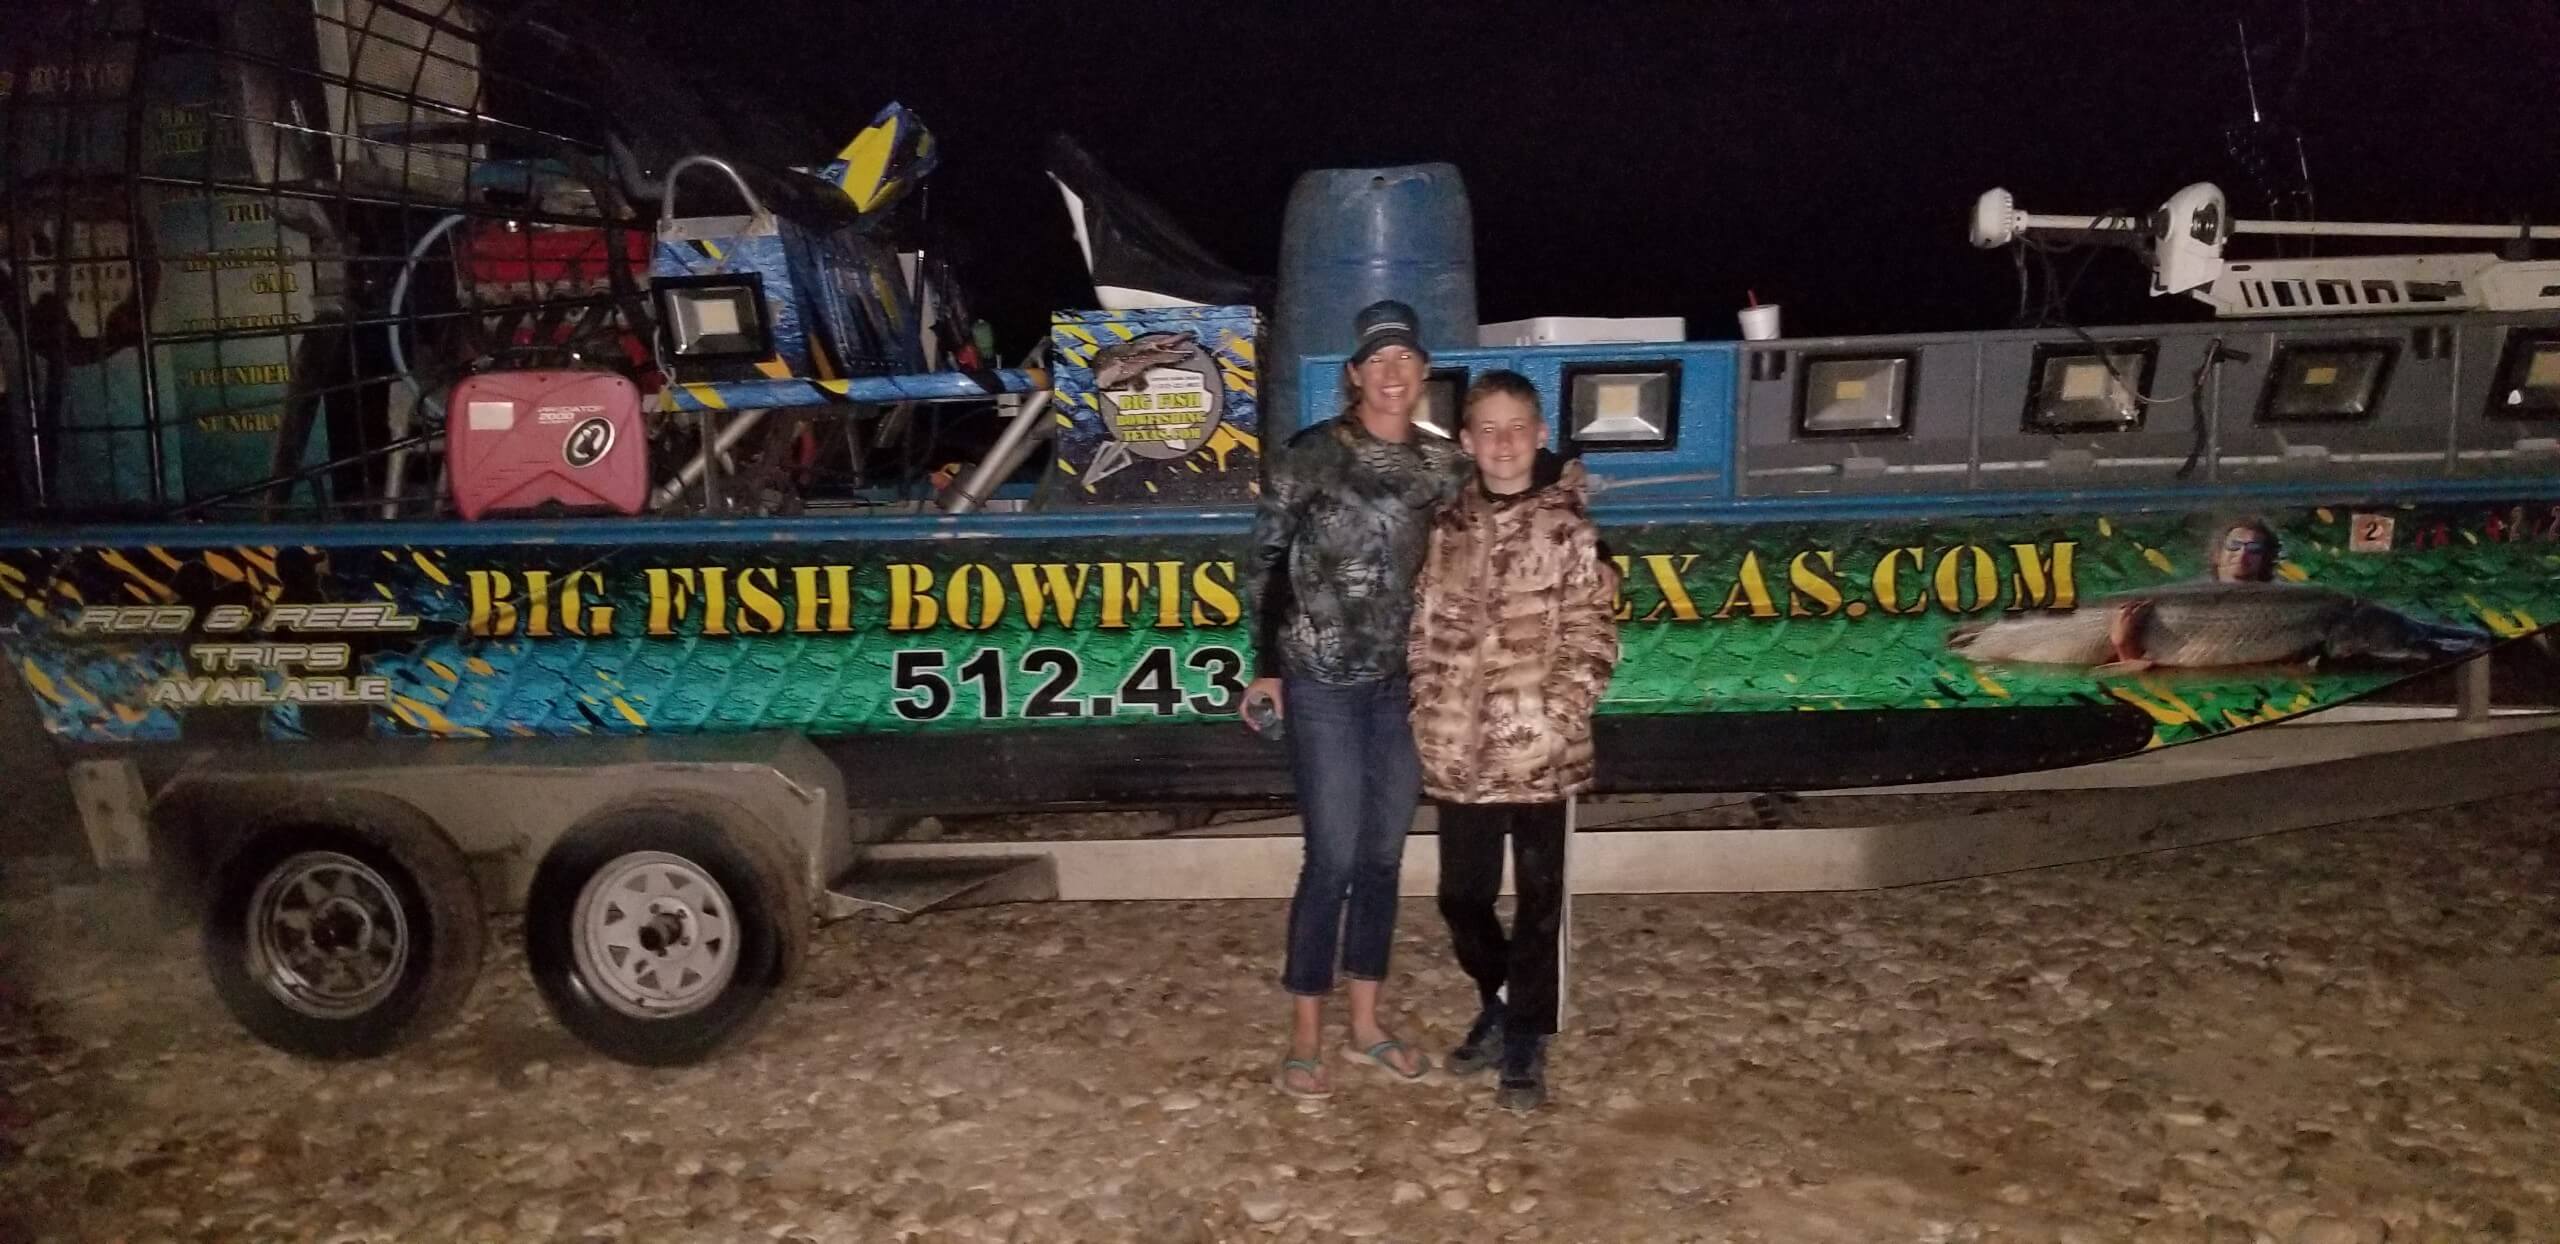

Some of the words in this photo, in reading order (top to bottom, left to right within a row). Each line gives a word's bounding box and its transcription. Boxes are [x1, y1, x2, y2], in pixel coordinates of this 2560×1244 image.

[1118, 394, 1153, 410] BIG
[1156, 392, 1201, 408] FISH
[2365, 521, 2379, 542] 2
[465, 570, 615, 637] BIG
[645, 565, 854, 636] FISH
[886, 561, 1242, 631] BOWFIS
[1610, 540, 2078, 621] EXAS.COM
[78, 605, 194, 633] ROD
[203, 604, 250, 632] &
[263, 602, 419, 632] REEL
[192, 643, 350, 671] TRIPS
[148, 677, 391, 704] AVAILABLE
[892, 645, 1248, 721] 512.43
